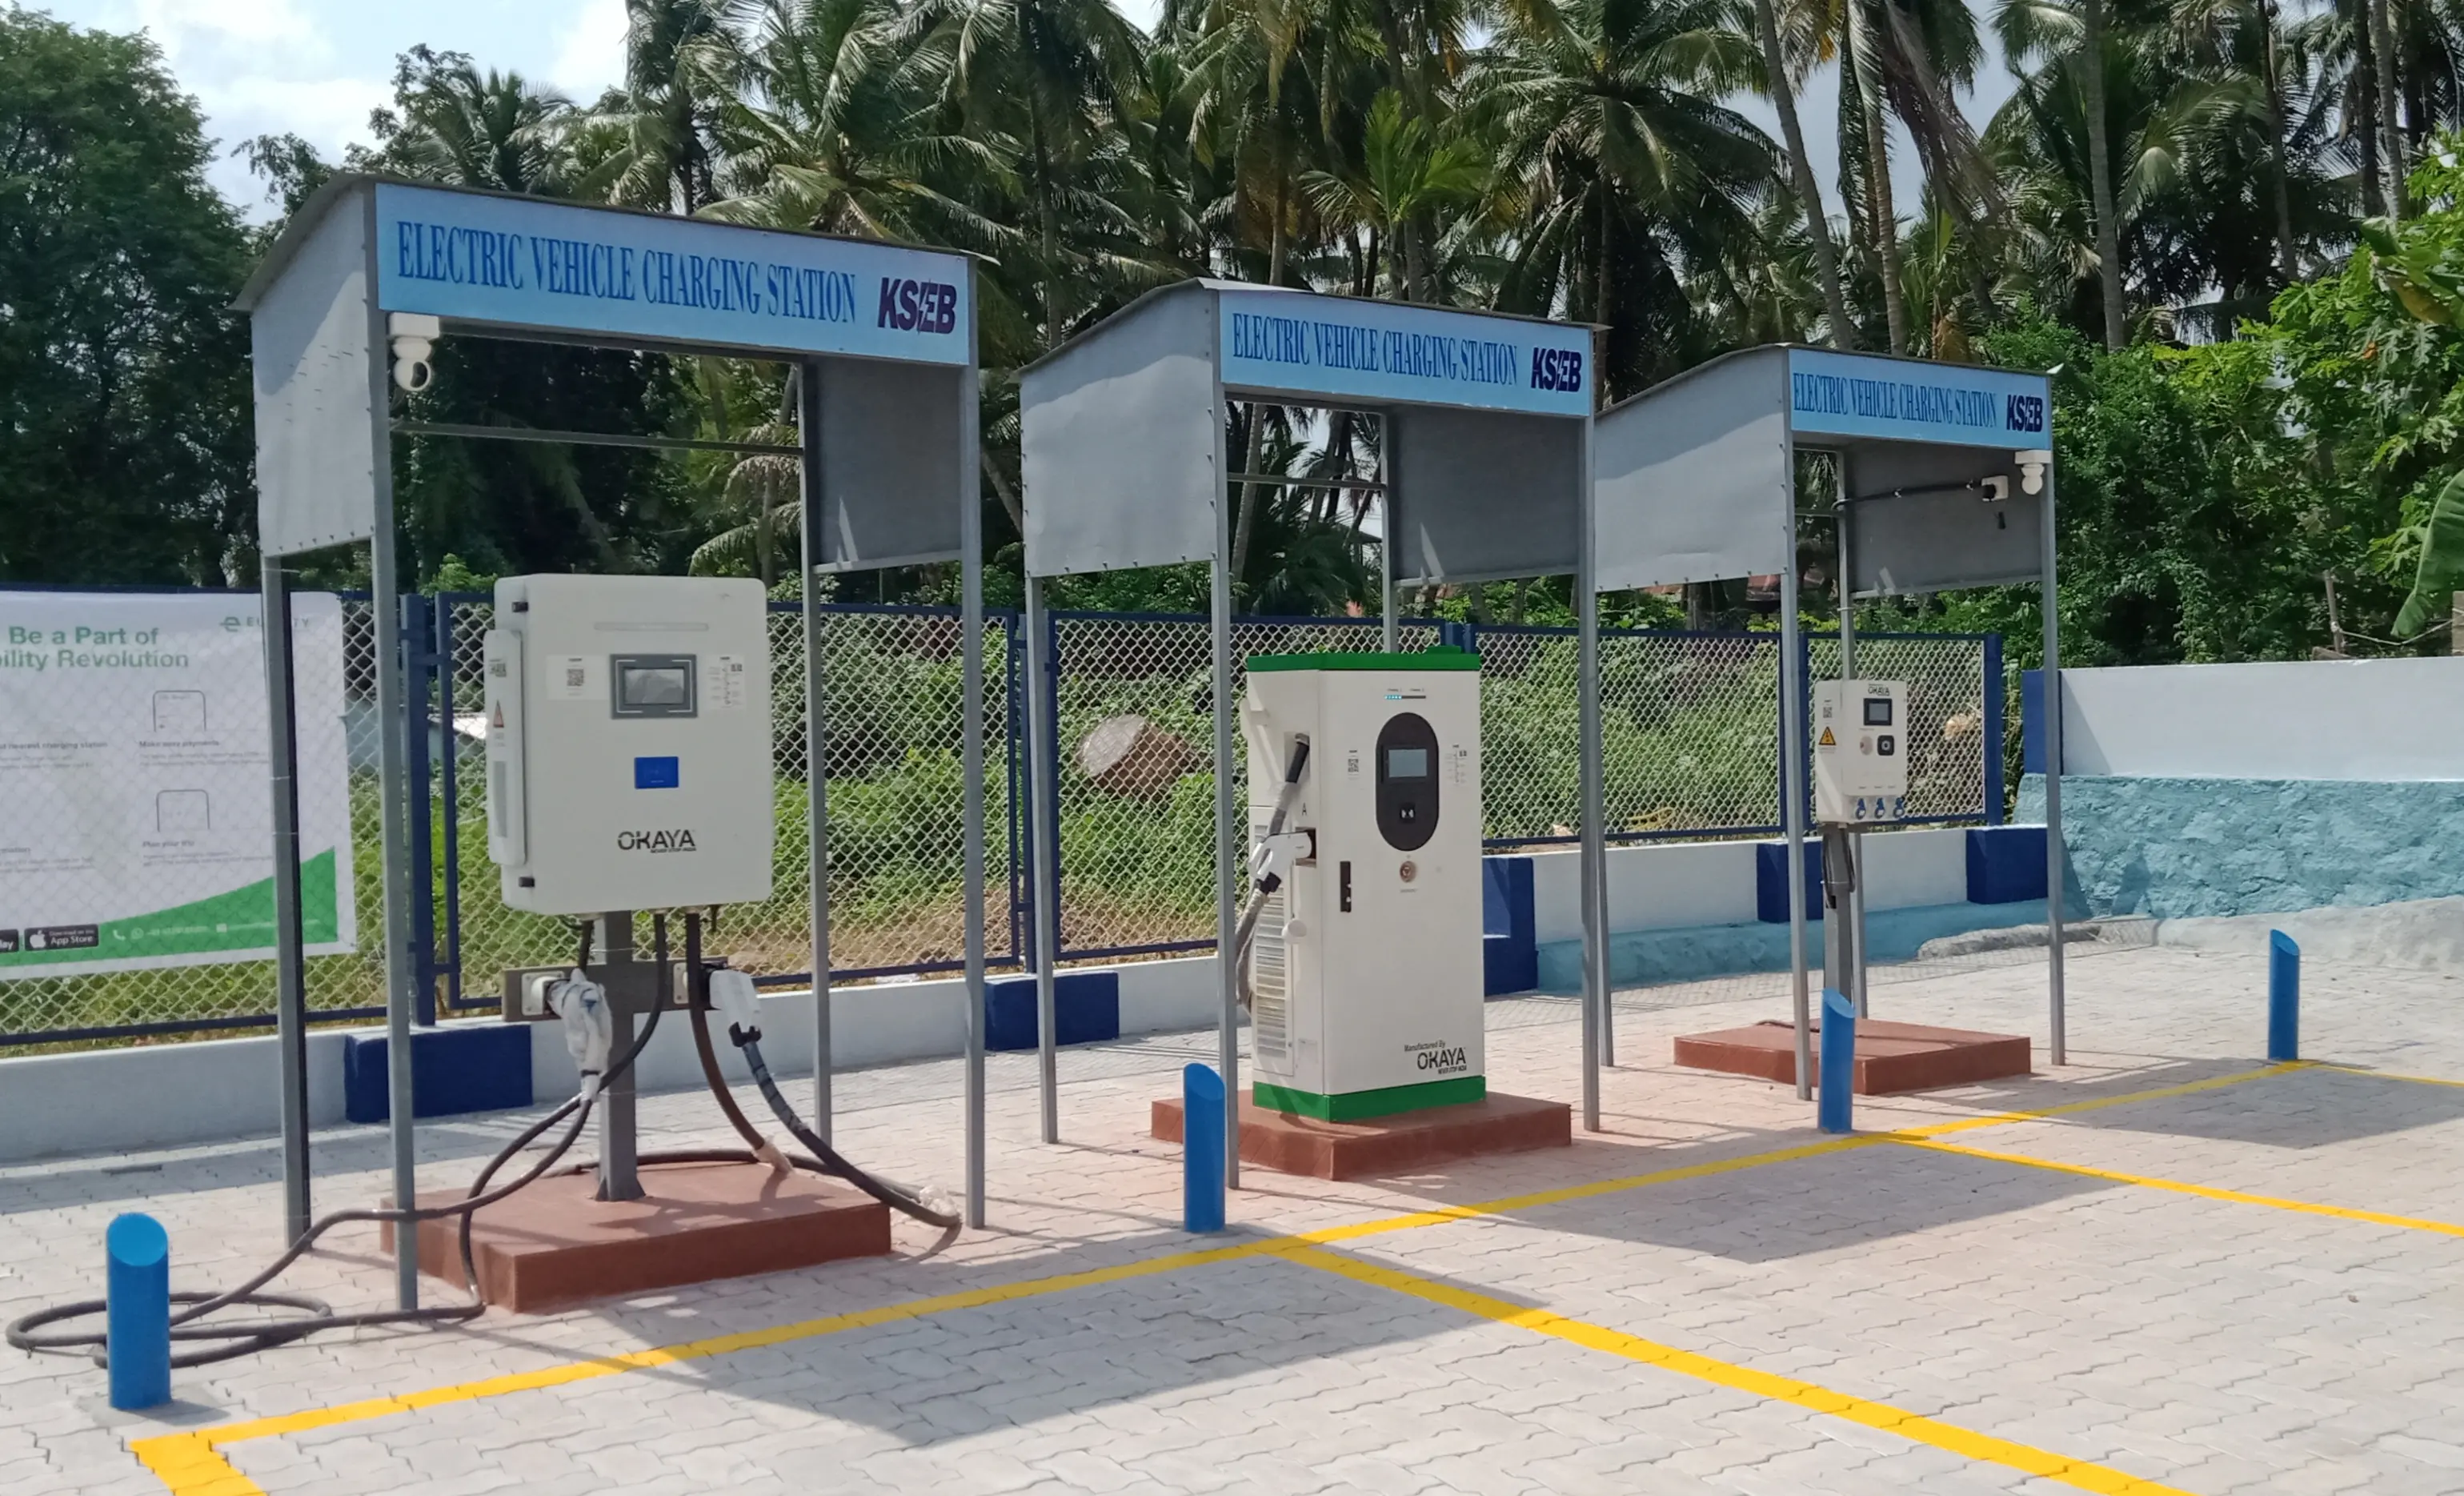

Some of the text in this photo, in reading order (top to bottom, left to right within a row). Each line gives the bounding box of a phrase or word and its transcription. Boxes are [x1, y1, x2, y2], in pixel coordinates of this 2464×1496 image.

[397, 221, 856, 324] ELECTRIC VEHICLE CHARGING STATION
[877, 276, 957, 335] KSEB
[1232, 313, 1517, 386] ELECTRIC VEHICLE CHARGING STATION
[1531, 347, 1582, 393] KSEB
[1793, 372, 1997, 427] ELECTRIC VEHICLE CHARGING STATION
[2006, 394, 2043, 433] KSEB
[9, 626, 159, 645] Be a Part of
[0, 649, 189, 672] ility Revolution
[1301, 802, 1308, 816] A
[618, 829, 695, 850] OKAYA
[1416, 1047, 1466, 1070] OKAYA
